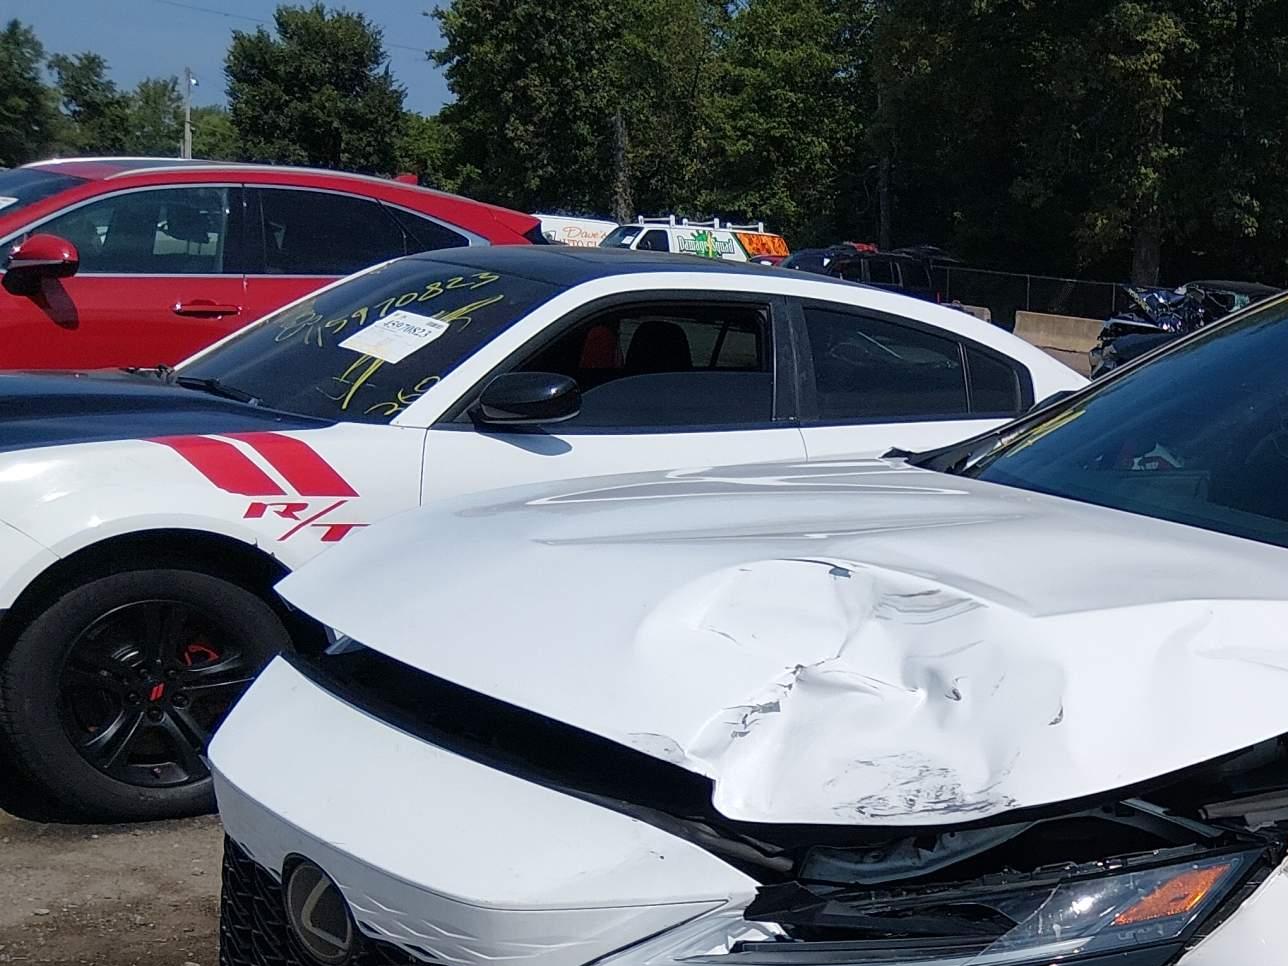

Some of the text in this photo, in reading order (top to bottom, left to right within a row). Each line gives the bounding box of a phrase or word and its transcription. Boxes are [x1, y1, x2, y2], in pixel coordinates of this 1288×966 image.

[677, 235, 736, 257] Damage Squad
[243, 500, 371, 541] R/T
